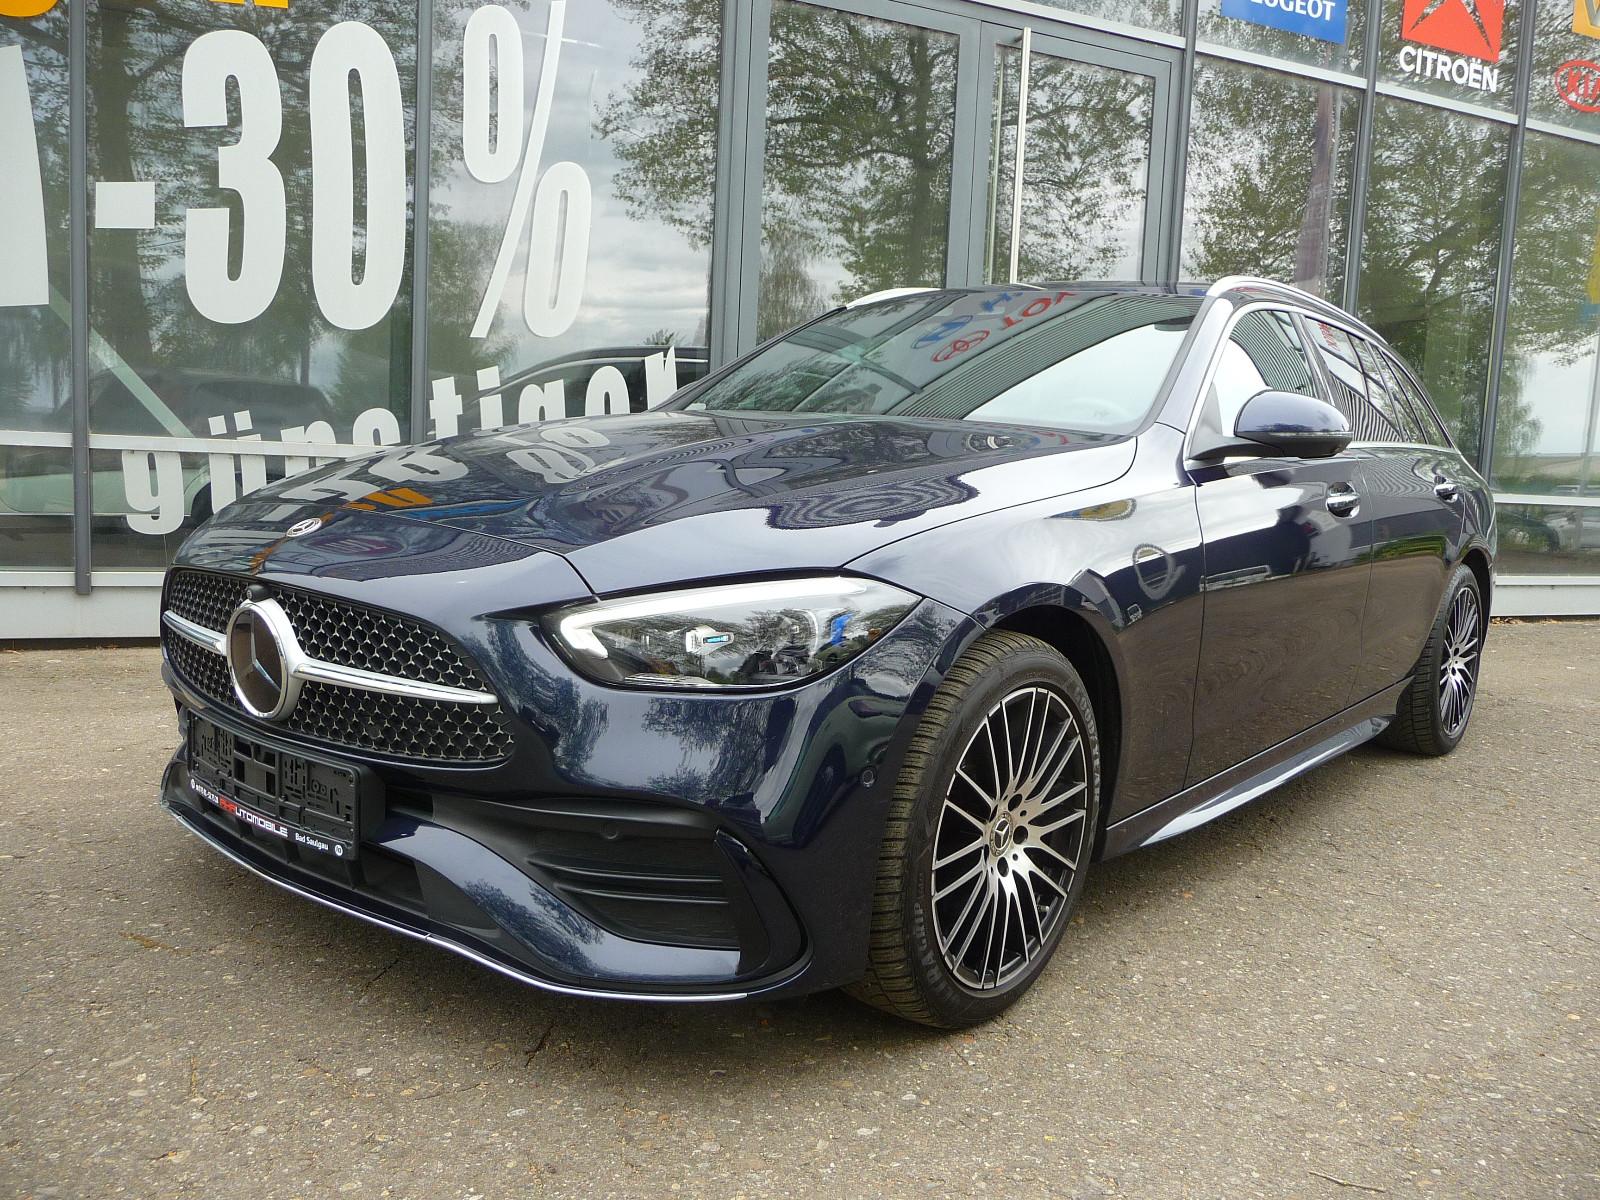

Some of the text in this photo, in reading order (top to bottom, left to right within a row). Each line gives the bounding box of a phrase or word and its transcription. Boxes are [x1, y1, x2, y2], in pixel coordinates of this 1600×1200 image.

[1249, 0, 1336, 21] GEOT
[1399, 46, 1499, 93] CITROËN
[295, 832, 306, 843] Bad
[307, 836, 329, 851] Saulgau
